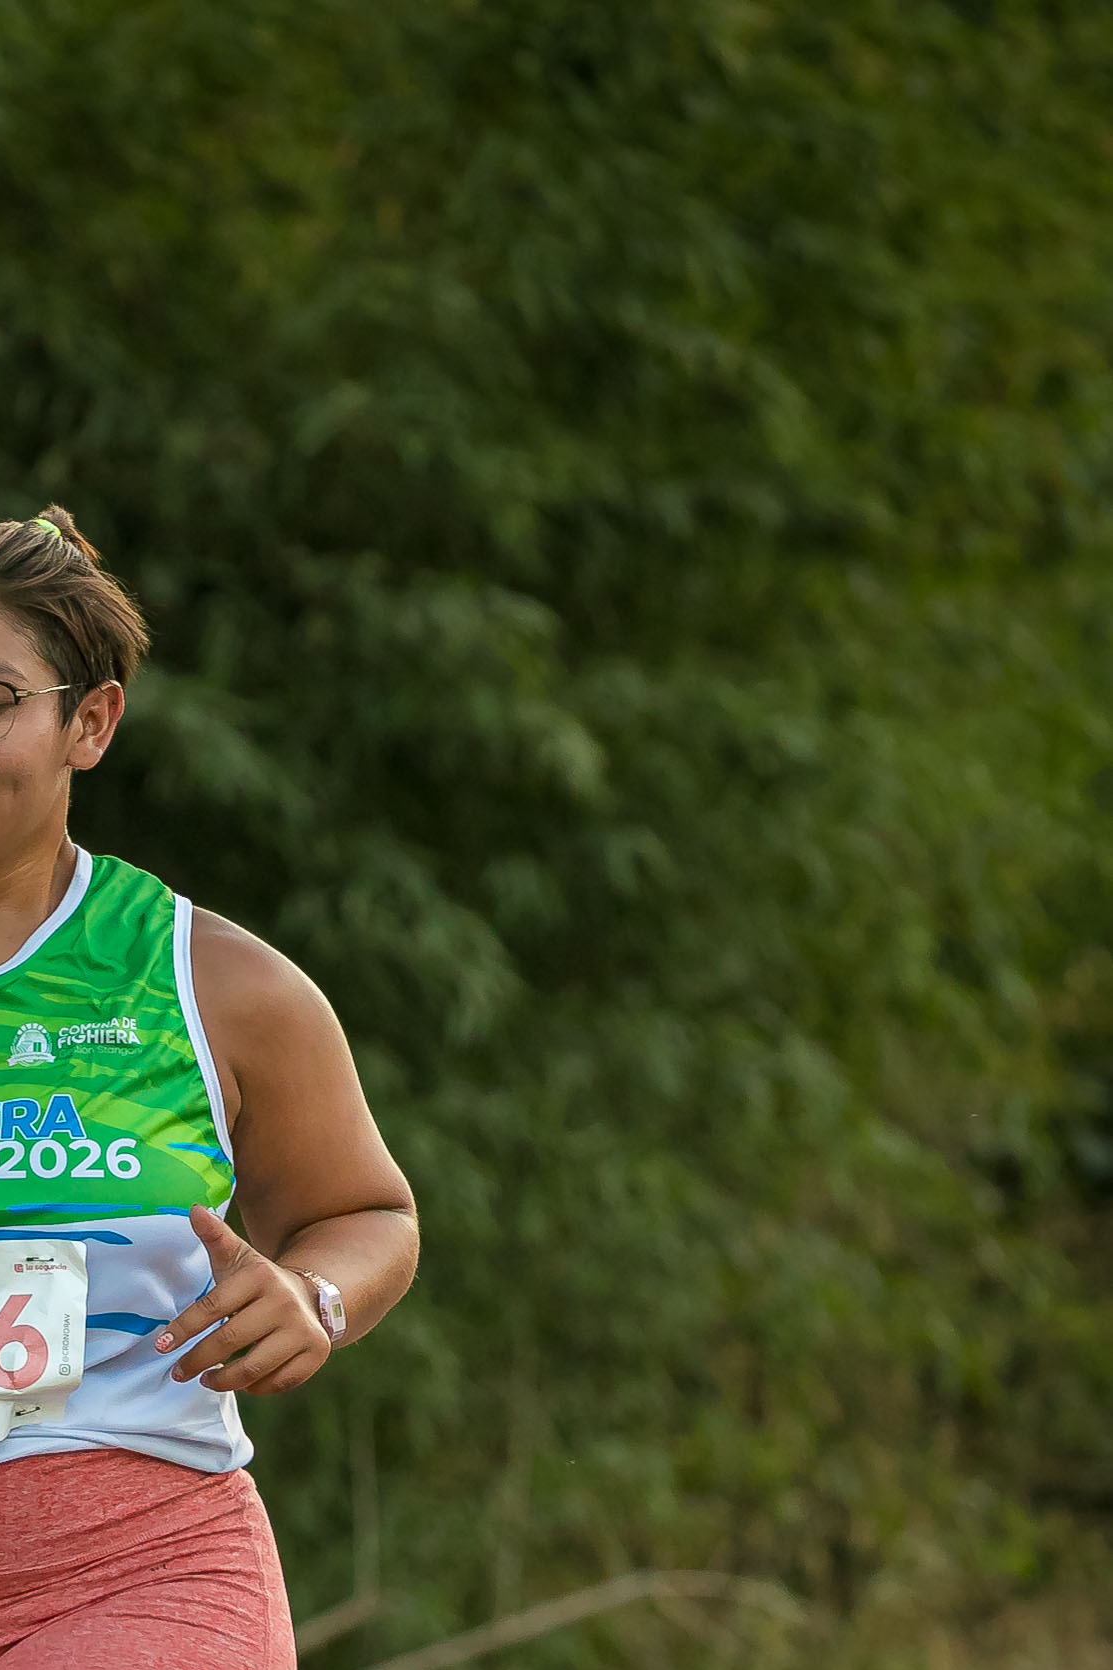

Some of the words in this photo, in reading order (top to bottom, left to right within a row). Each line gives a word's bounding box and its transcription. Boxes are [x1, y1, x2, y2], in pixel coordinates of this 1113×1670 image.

[58, 1018, 119, 1037] COMUNA
[122, 1016, 138, 1030] DE
[57, 1029, 142, 1049] FIGHIERA
